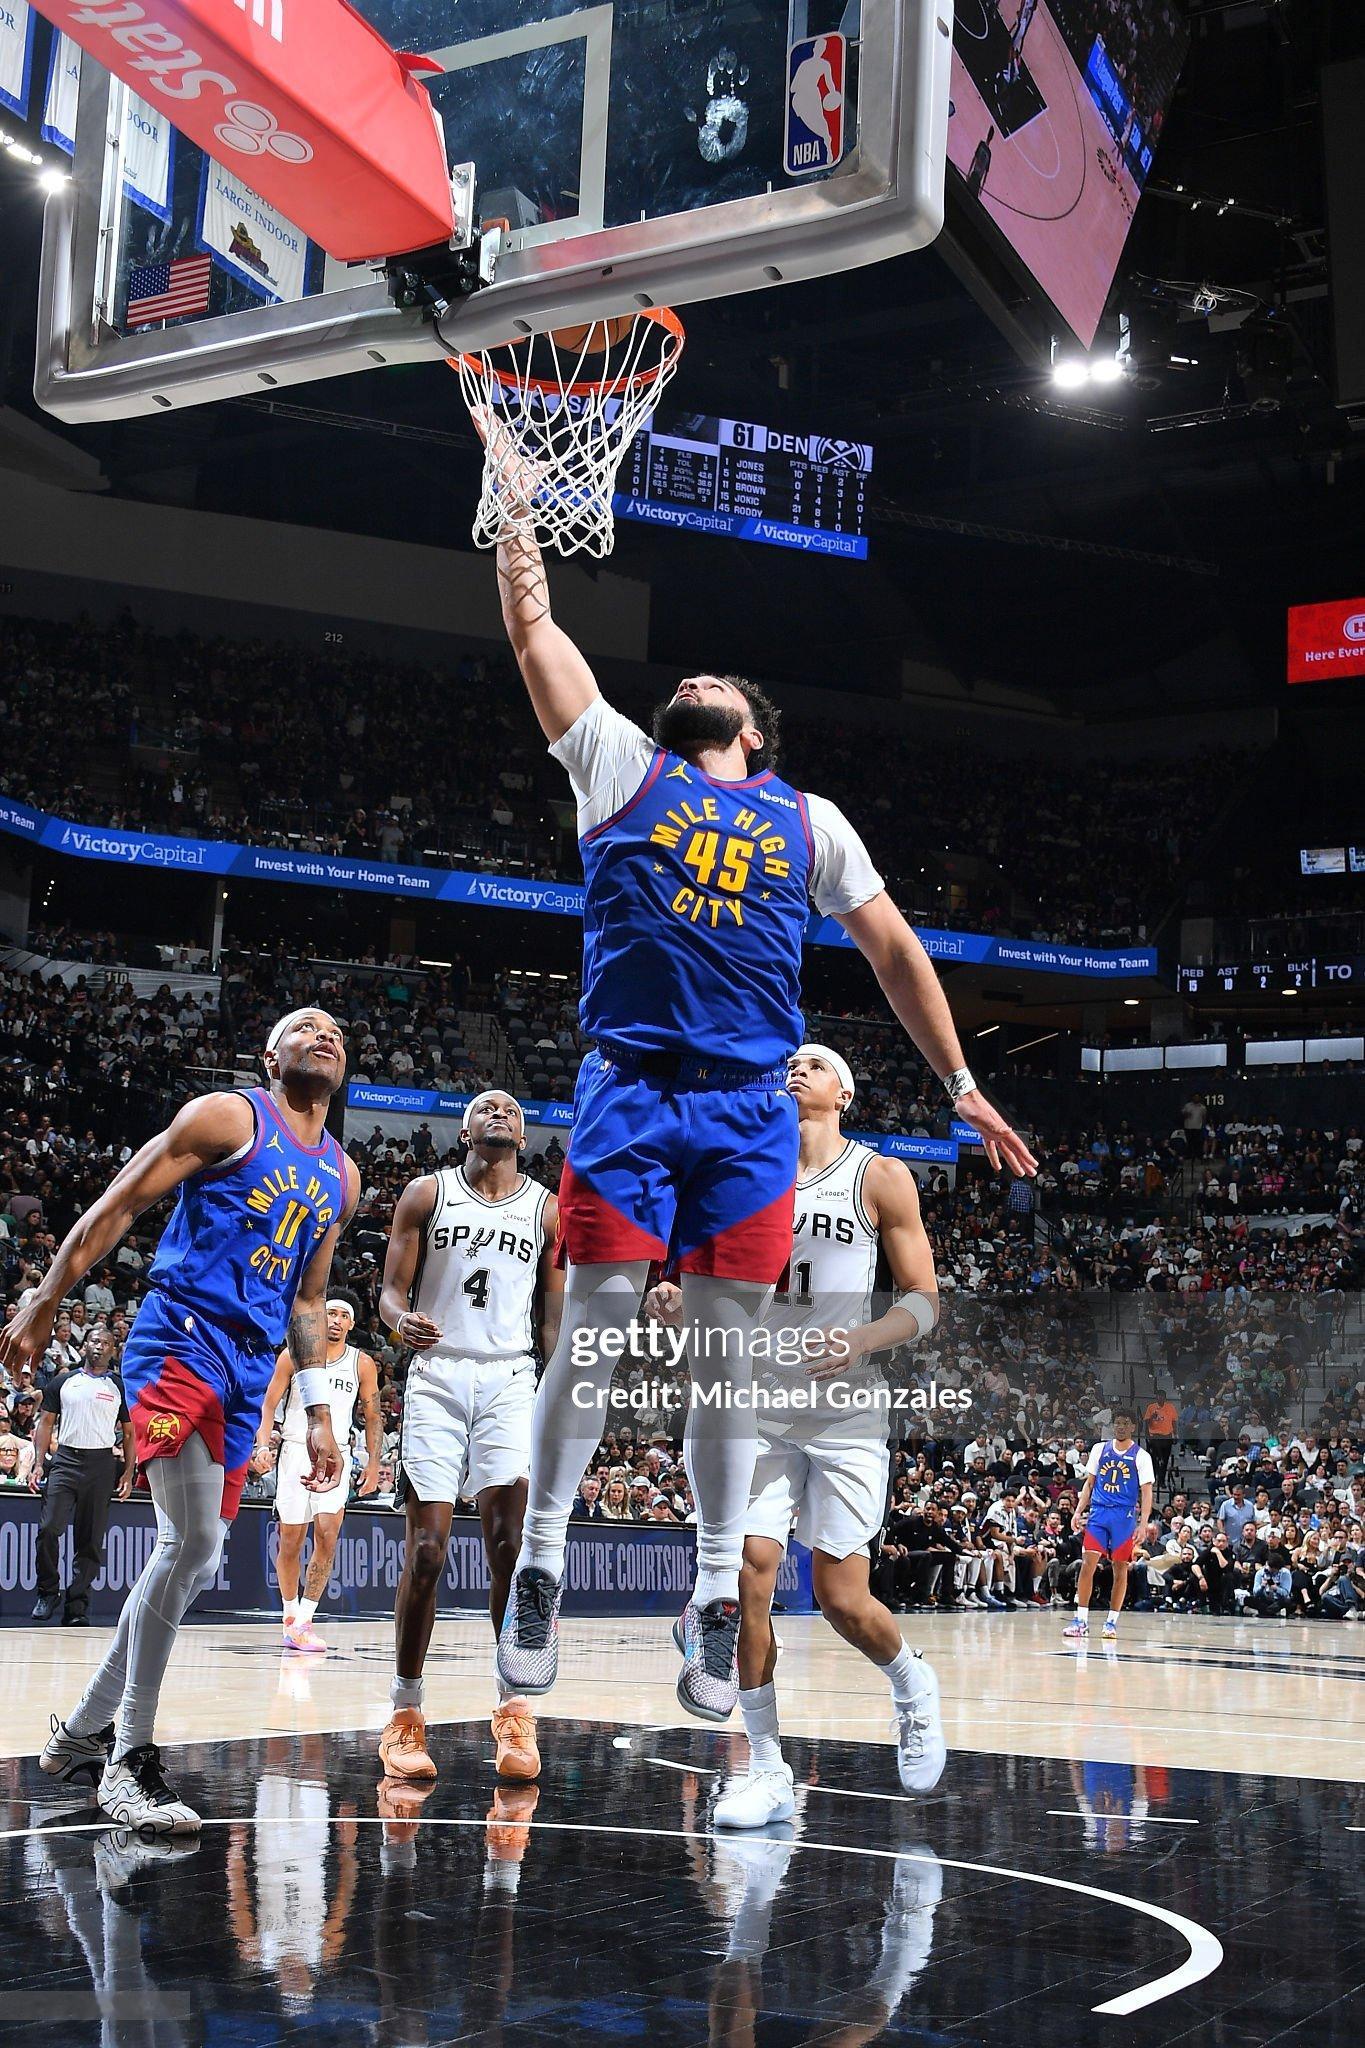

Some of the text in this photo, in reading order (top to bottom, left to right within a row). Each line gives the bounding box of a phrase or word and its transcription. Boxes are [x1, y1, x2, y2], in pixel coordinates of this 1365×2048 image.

[793, 140, 820, 167] NBA
[216, 178, 252, 217] LARGE
[255, 210, 298, 253] INDOOR
[732, 423, 809, 456] 61 DEN
[723, 468, 865, 502] 5 JONES 0 1 3 0
[725, 457, 864, 491] 1 JONES 10 3 2 1
[789, 460, 868, 481] PTS REB AST PF
[720, 491, 862, 525] 15 JOKIC 21 8 1 1
[722, 480, 863, 514] 11 BROWN 4 4 1 0
[718, 503, 861, 537] 45 RODDY 2 5 0 1
[763, 524, 857, 554] VictoryCapital
[324, 632, 343, 643] 212
[1305, 651, 1335, 662] Here
[11, 811, 35, 831] Team
[72, 831, 206, 866] VictoryCapital
[650, 798, 790, 878] MILE HIGH
[255, 857, 430, 888] Invest with Your Home Team
[684, 831, 755, 893] 45
[672, 887, 744, 929] CITY
[998, 947, 1149, 969] Invest with Your Home Team
[1182, 963, 1352, 979] REB AST STL BLK TO
[1189, 974, 1301, 992] 15 10 2 2
[361, 1090, 424, 1107] VictoryCapital
[440, 1099, 462, 1109] Invest
[1205, 1094, 1224, 1105] 113
[895, 1141, 952, 1156] VictoryCapital
[247, 1166, 299, 1214] MILE
[820, 1190, 845, 1198] LEDGER
[274, 1200, 309, 1248] 11
[434, 1225, 533, 1263] SPURS
[250, 1246, 292, 1280] CITY
[462, 1267, 490, 1311] 4
[1103, 1483, 1120, 1493] CITY
[1111, 1470, 1117, 1484] 1
[616, 1542, 693, 1592] COURTSIDE
